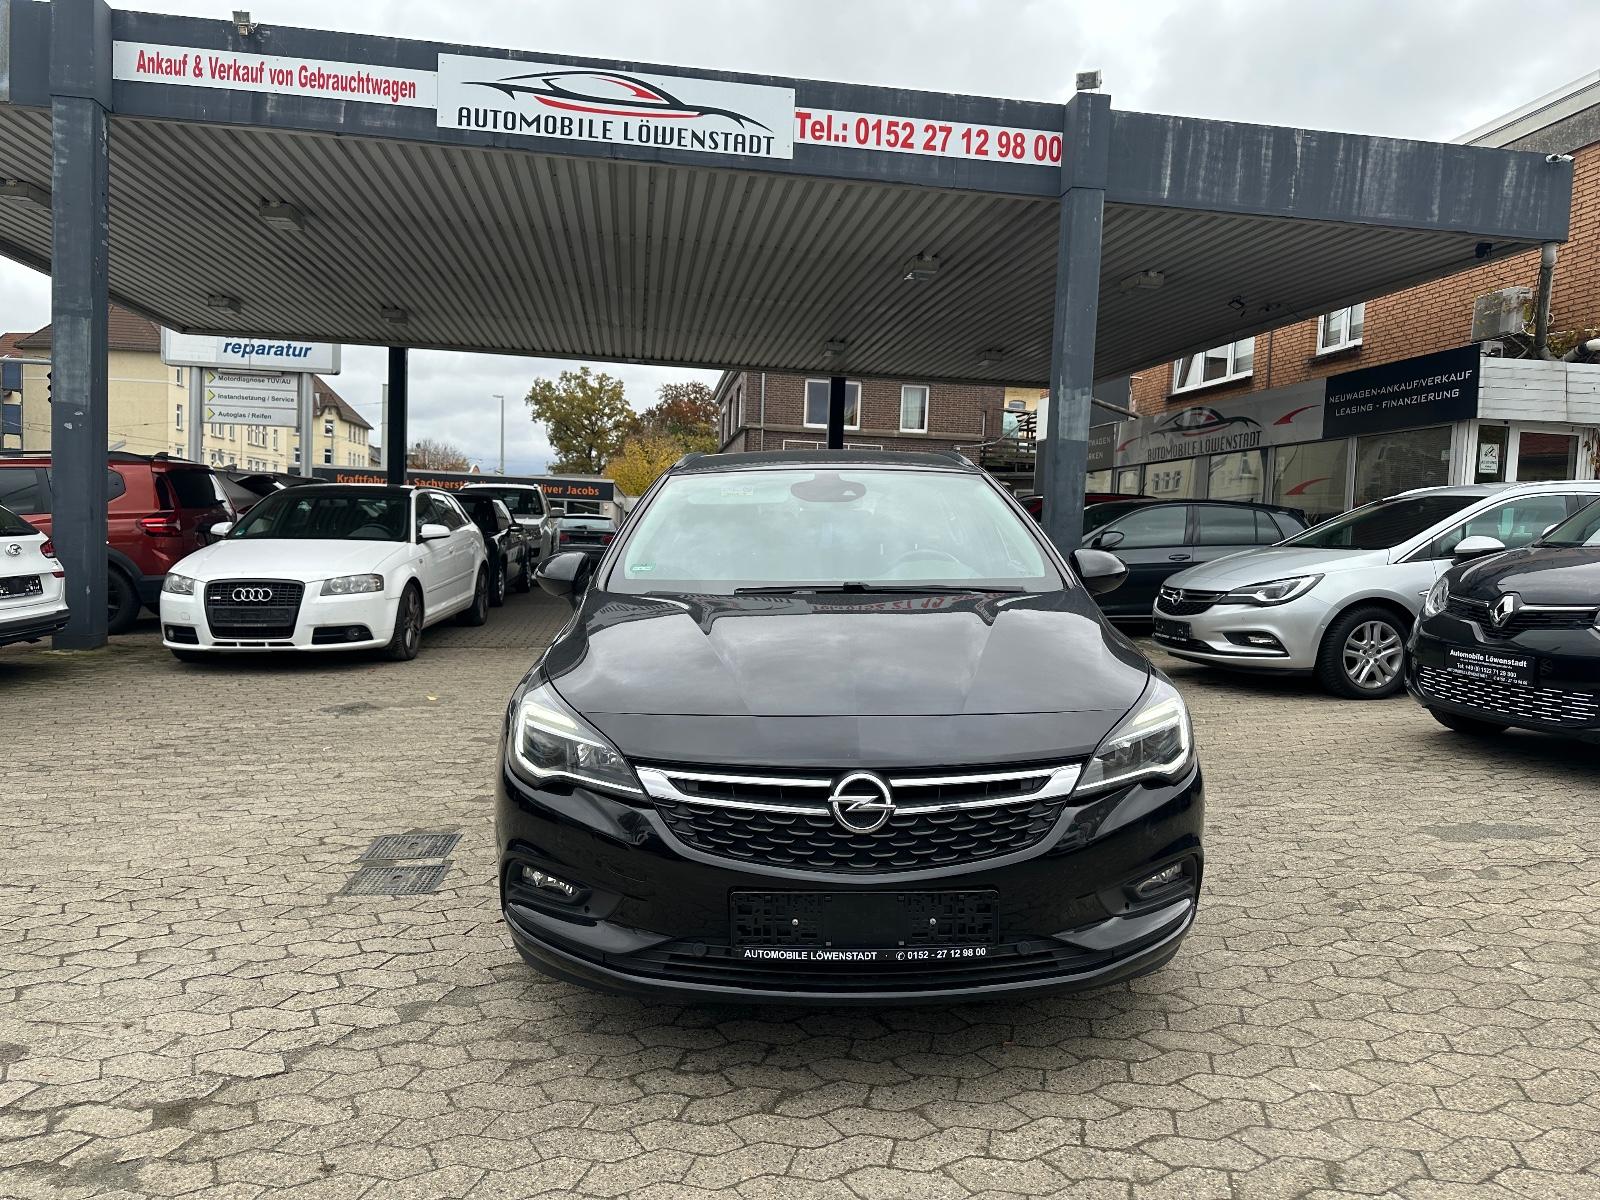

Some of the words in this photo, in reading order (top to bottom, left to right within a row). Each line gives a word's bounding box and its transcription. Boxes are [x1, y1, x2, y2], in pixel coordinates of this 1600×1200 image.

[136, 50, 188, 77] Ankauf
[193, 54, 203, 78] &
[209, 56, 265, 85] Verkauf
[269, 67, 294, 86] von
[298, 65, 417, 103] Gebrauchtwagen
[457, 106, 614, 141] AUTOMOBILE
[623, 119, 775, 155] LÖWENSTADT
[795, 111, 848, 143] Tel.:
[855, 117, 915, 149] 0152
[922, 124, 953, 153] 27
[961, 128, 989, 156] 12
[997, 131, 1026, 160] 98
[1034, 134, 1063, 163] 00
[222, 342, 312, 358] reparatur
[218, 374, 267, 384] Motordiagnose
[217, 393, 266, 402] Instandsetzung
[1335, 402, 1373, 416] LEASING
[1382, 388, 1460, 409] FINANZIERUNG
[217, 411, 246, 419] Autoglas
[251, 412, 272, 420] Reifen
[1148, 440, 1198, 461] AUTOMOBILE
[1200, 430, 1263, 455] LÖWENSTADT
[540, 483, 563, 495] liver
[567, 485, 600, 496] Jacobs
[1449, 649, 1484, 661] Automobile
[1485, 654, 1527, 668] Löwenstadt
[744, 949, 808, 960] AUTOMOBILE
[811, 950, 877, 961] LÖWENSTADT
[907, 950, 929, 960] 0152
[936, 949, 948, 959] 27
[950, 949, 961, 959] 12
[962, 948, 974, 957] 98
[975, 947, 986, 957] 00
